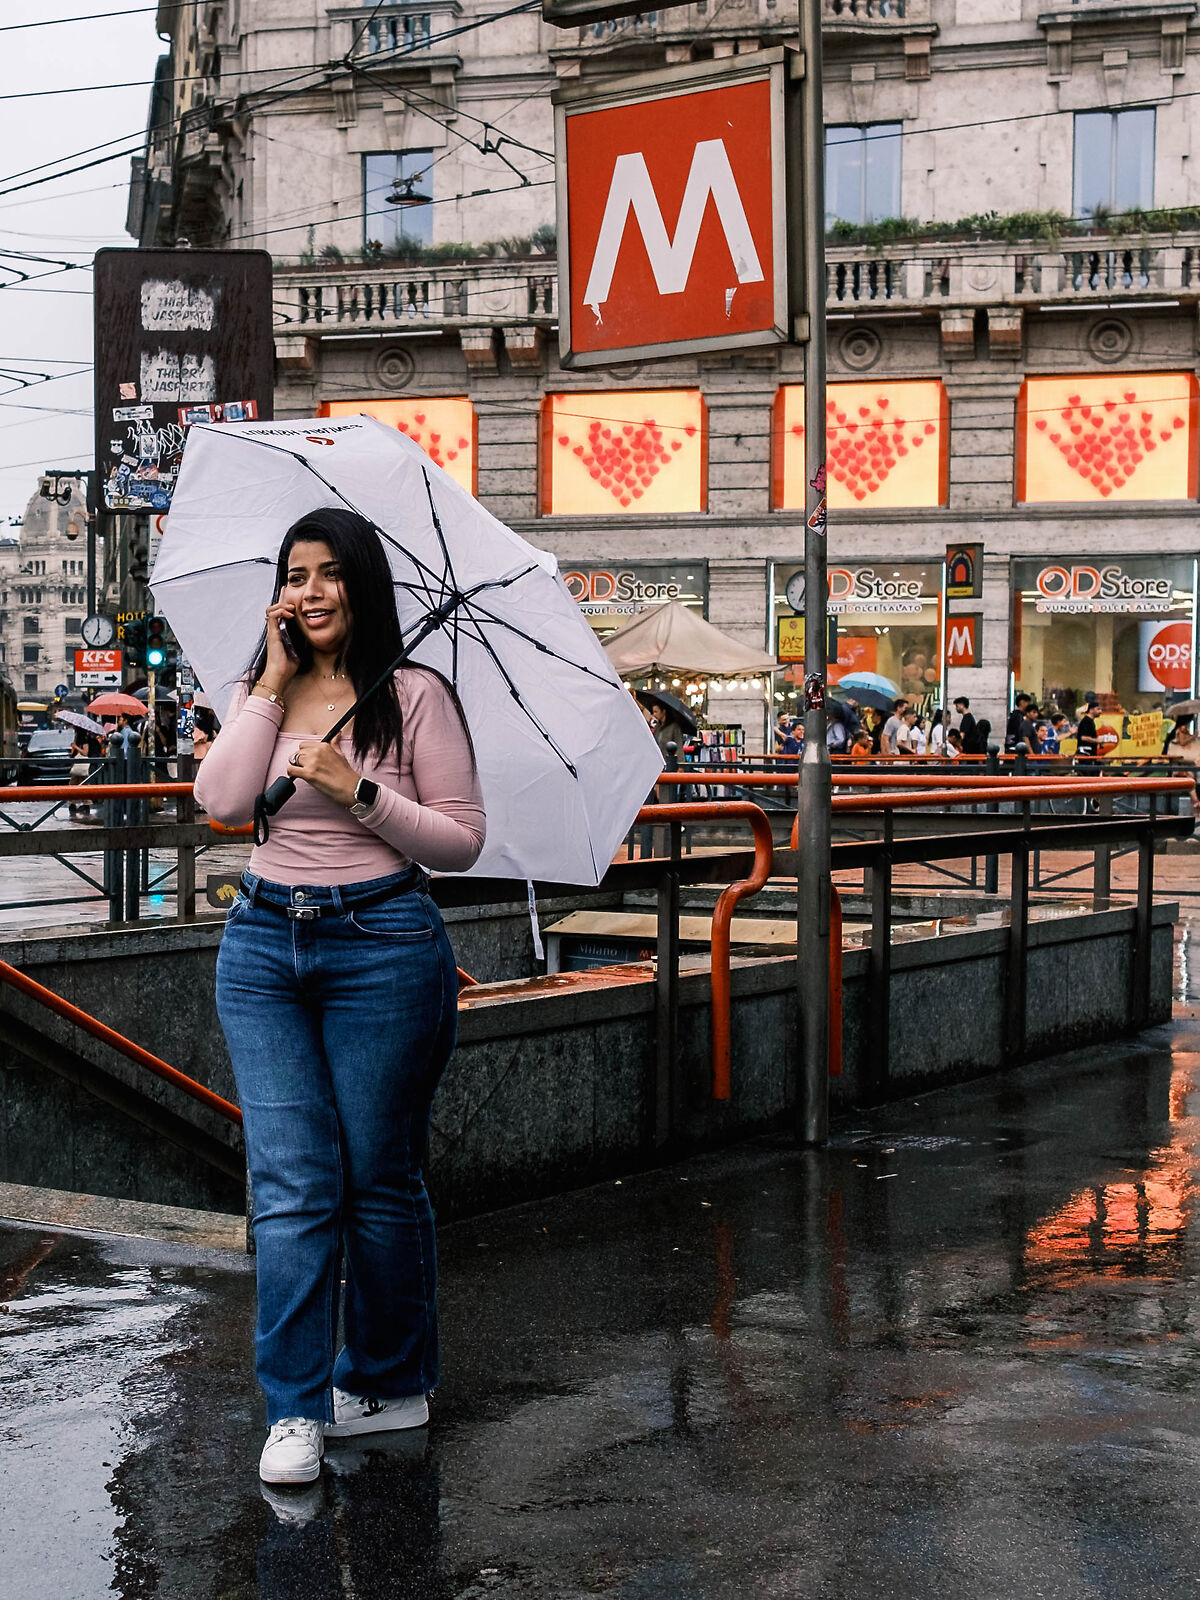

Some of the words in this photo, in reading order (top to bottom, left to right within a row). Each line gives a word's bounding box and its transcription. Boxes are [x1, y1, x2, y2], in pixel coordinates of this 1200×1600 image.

[583, 138, 765, 305] M
[827, 568, 921, 599] DStore
[1037, 565, 1170, 599] ODStore
[947, 626, 973, 656] M
[81, 650, 116, 663] KFC
[1156, 660, 1188, 669] ITAL
[577, 943, 618, 957] Milano
